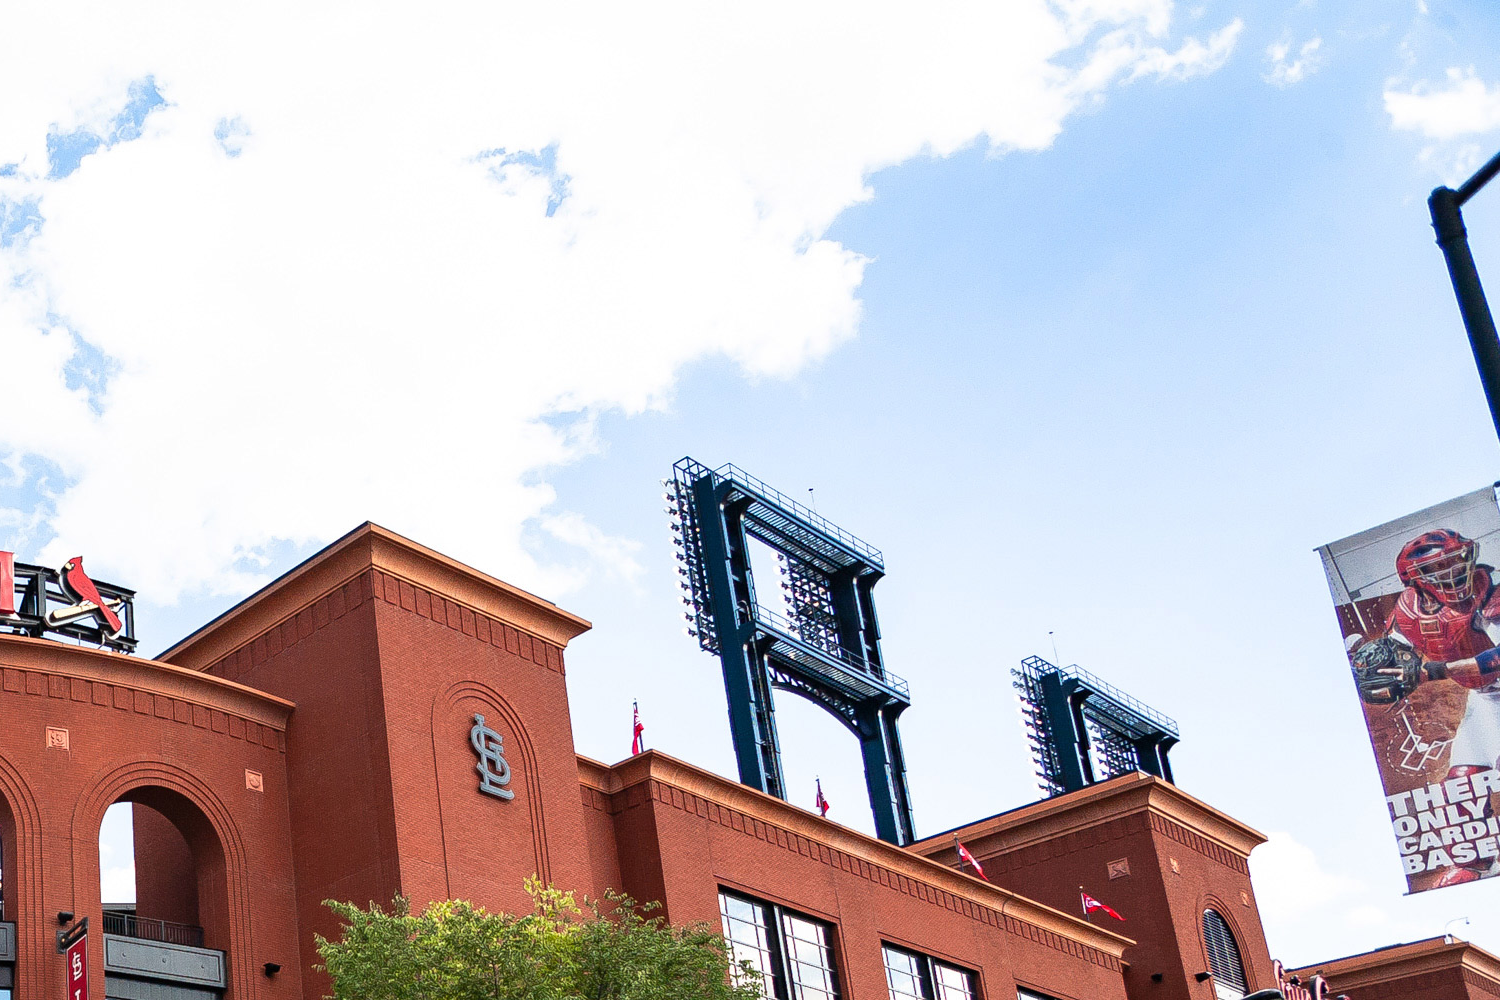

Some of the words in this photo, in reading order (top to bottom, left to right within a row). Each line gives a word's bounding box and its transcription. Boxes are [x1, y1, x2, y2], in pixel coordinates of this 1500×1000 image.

[1393, 797, 1488, 837] ONLY
[1398, 815, 1500, 855] CARDI
[1402, 835, 1500, 875] BASE
